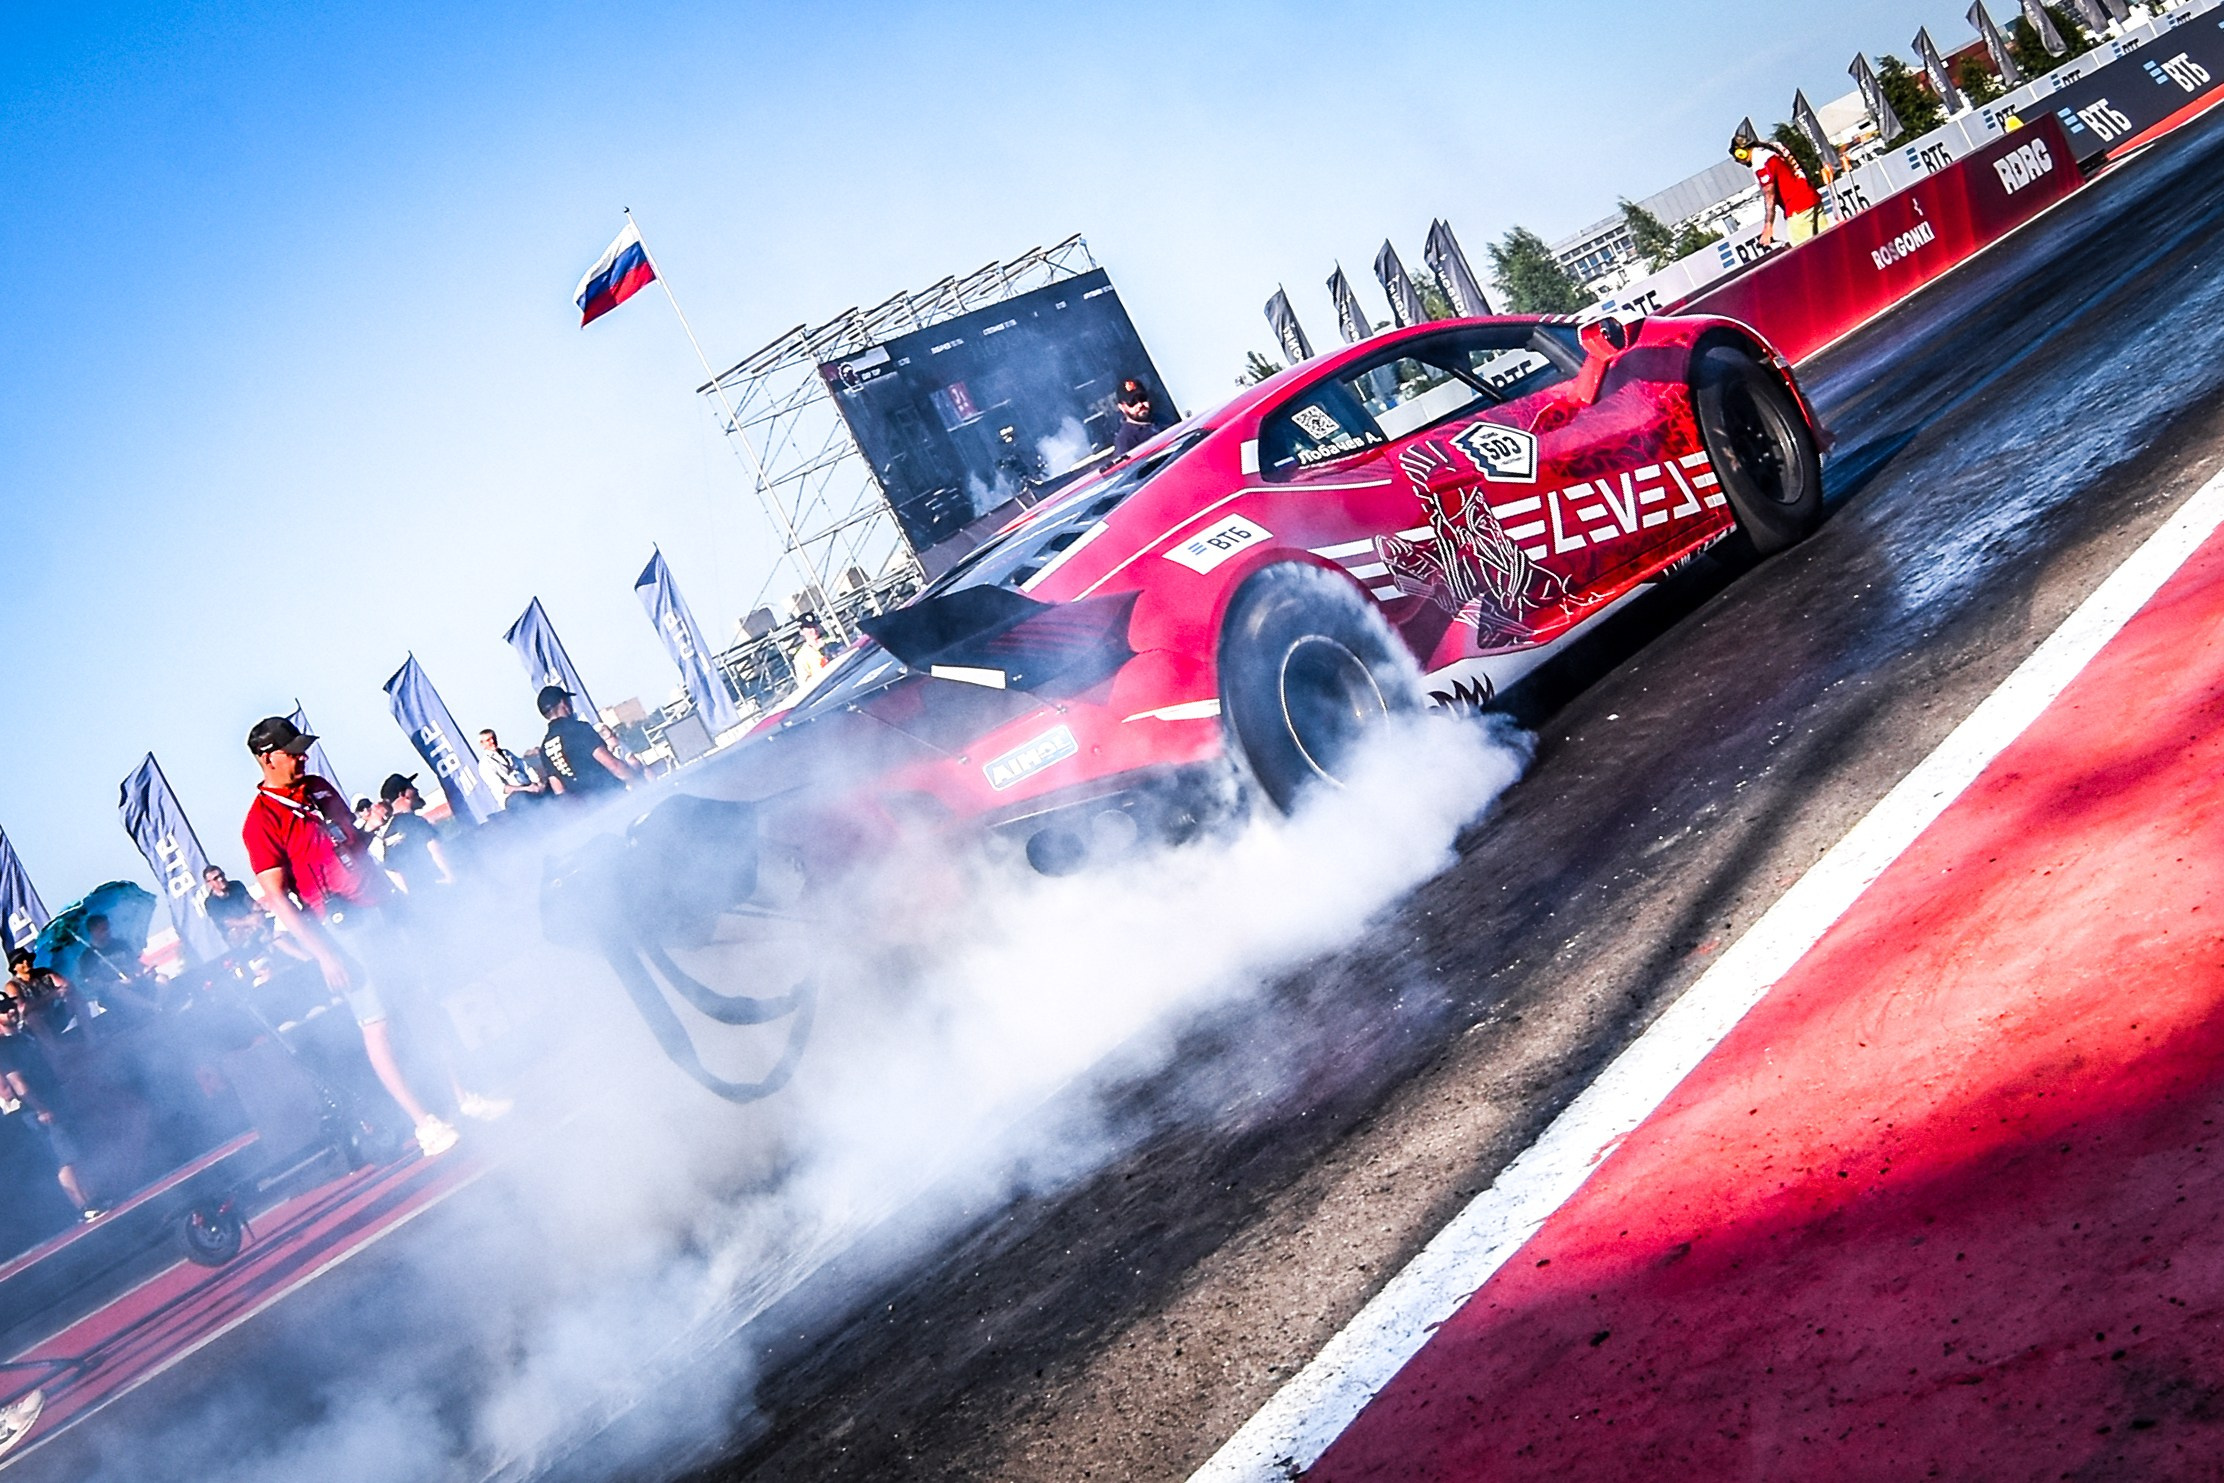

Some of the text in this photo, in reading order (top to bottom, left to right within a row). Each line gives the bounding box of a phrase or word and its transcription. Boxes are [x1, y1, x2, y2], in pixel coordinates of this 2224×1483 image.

[2160, 52, 2211, 93] ВТБ
[2077, 98, 2132, 142] ВТБ
[1992, 137, 2053, 195] RDRC
[1870, 220, 1936, 271] ROSGONKI
[1297, 431, 1383, 465] Лобачев А.
[1480, 436, 1521, 461] 503
[1206, 526, 1252, 550] ВТБ
